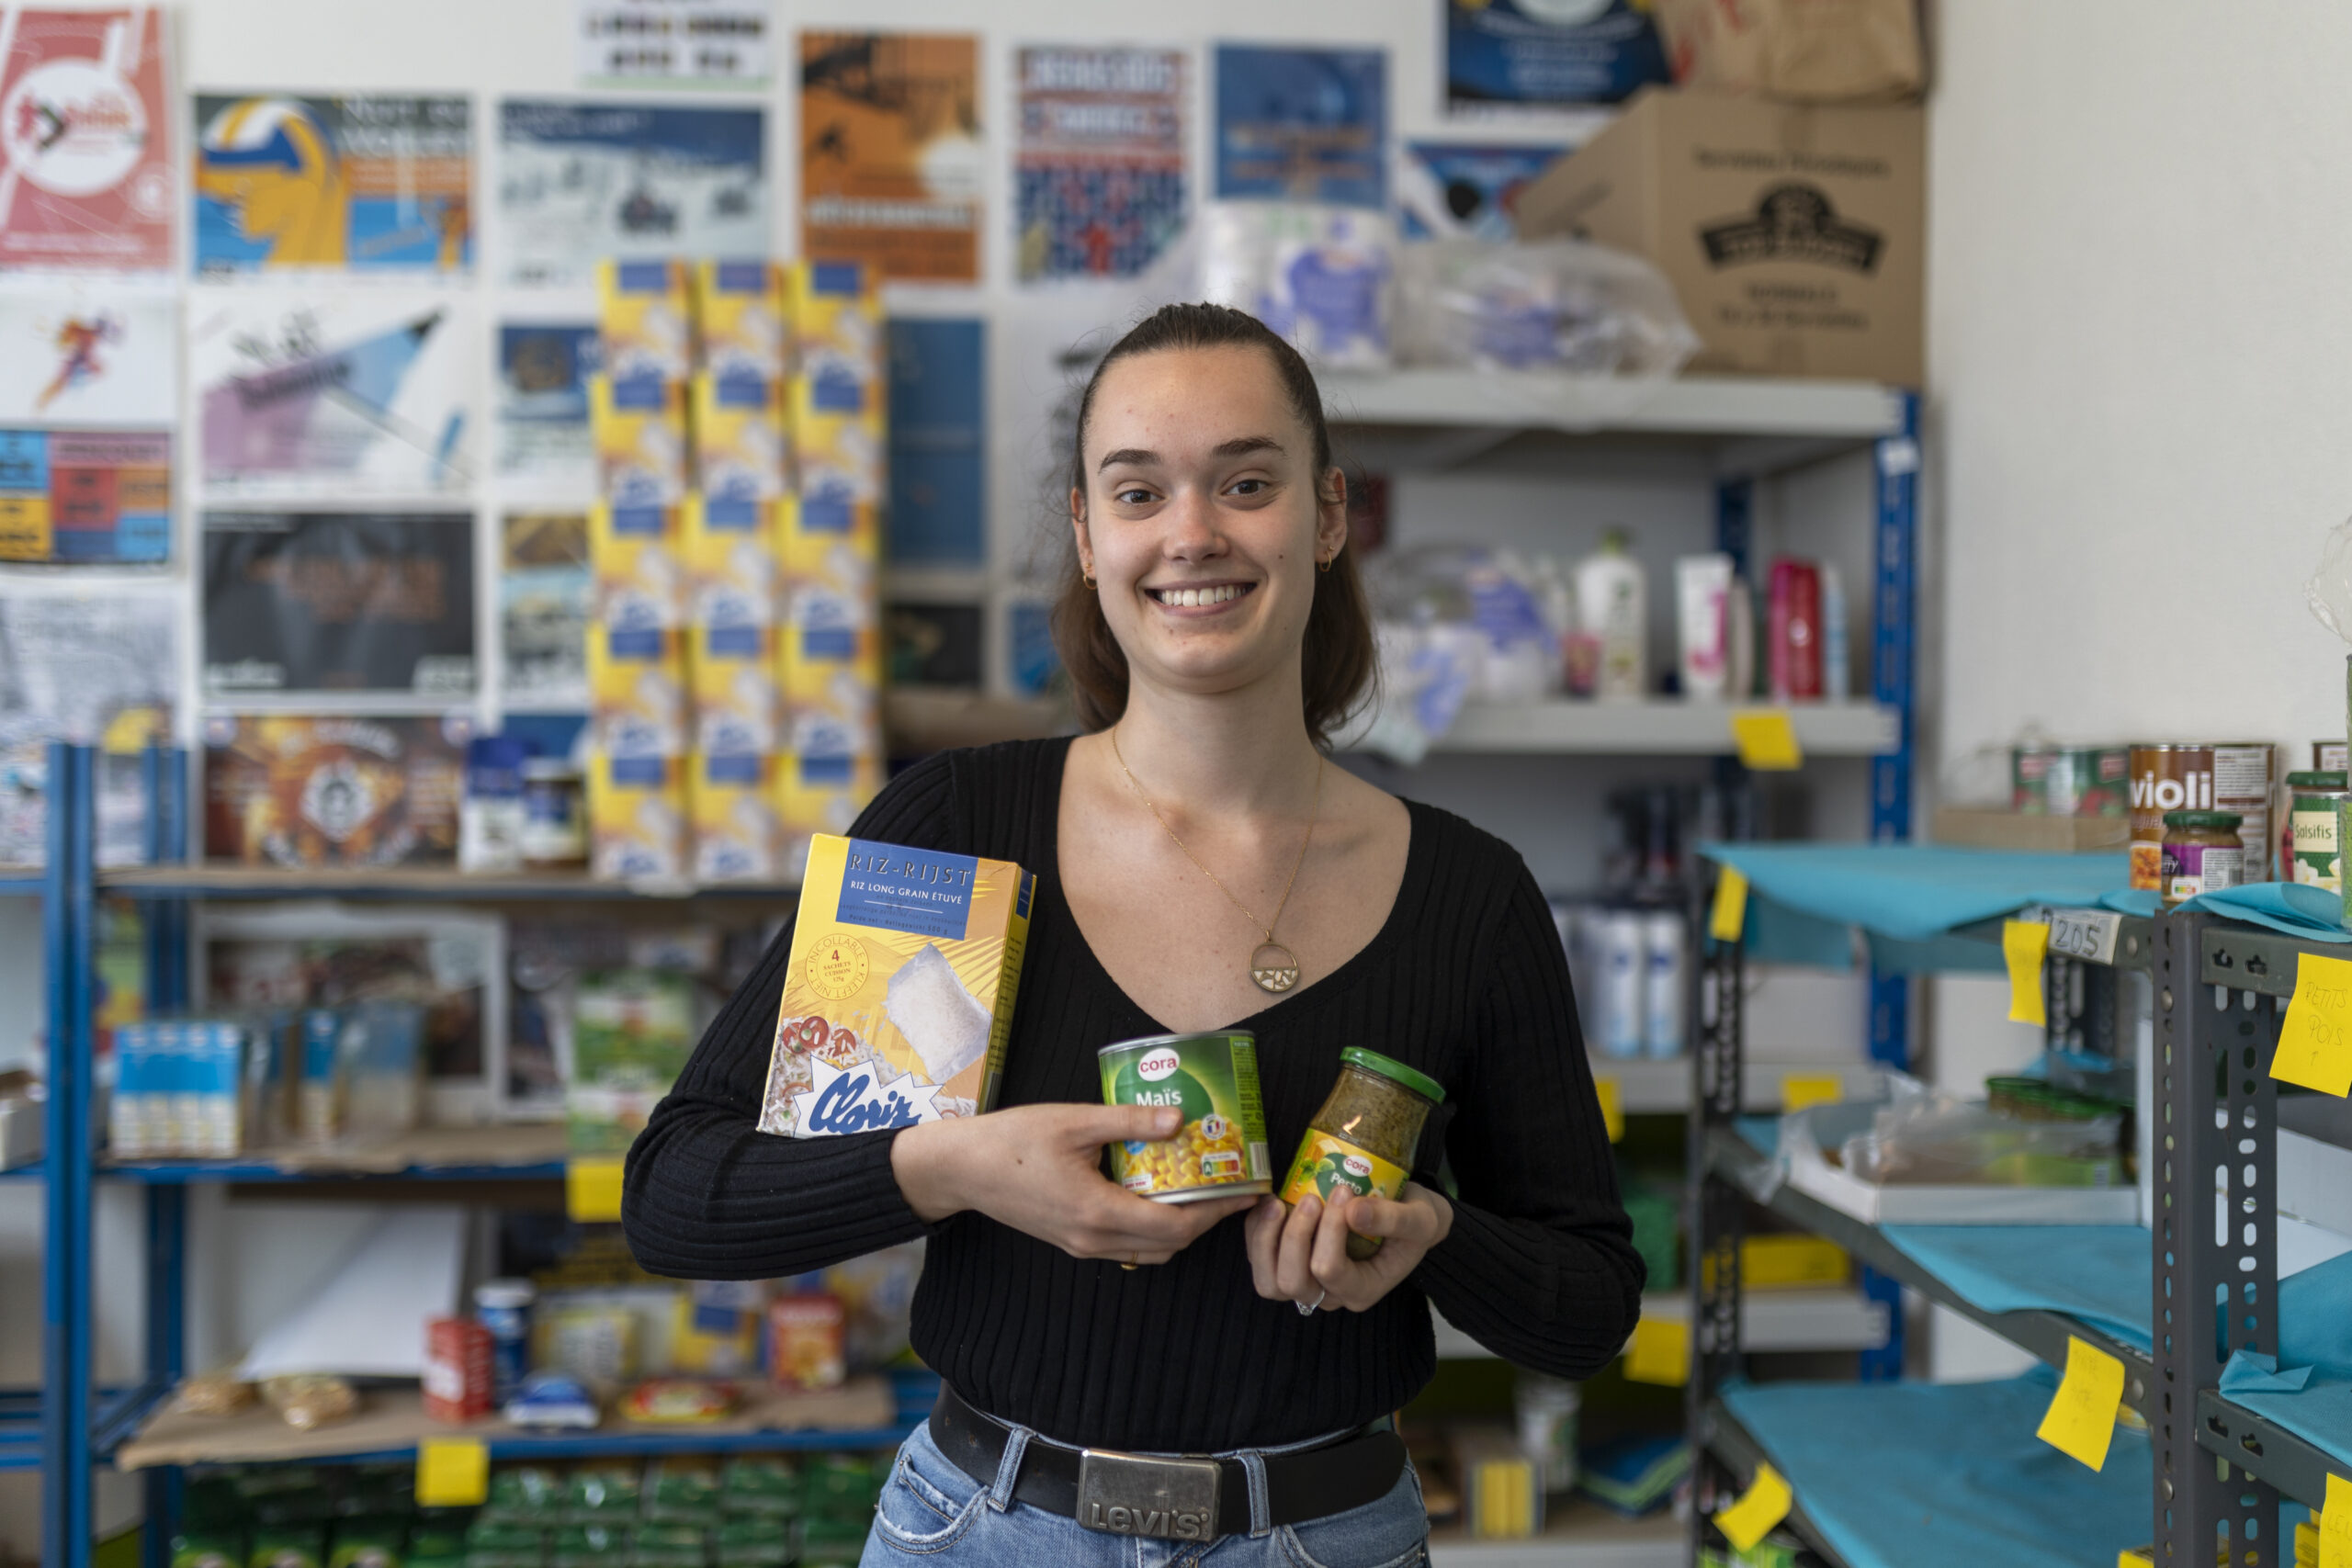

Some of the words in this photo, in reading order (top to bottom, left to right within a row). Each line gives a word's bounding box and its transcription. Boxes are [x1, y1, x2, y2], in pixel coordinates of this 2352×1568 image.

[2295, 824, 2333, 840] Salsifis
[850, 853, 971, 886] RIZ-RIJST
[851, 880, 865, 890] RIZ
[868, 884, 895, 895] LONG
[898, 887, 930, 899] GRAIN
[932, 891, 963, 905] ÉTUVÉ
[831, 949, 841, 962] 4
[2305, 980, 2348, 1010] PETITS
[2307, 1013, 2345, 1046] POIS
[1140, 1057, 1177, 1073] cora
[1136, 1088, 1183, 1108] Maïs
[1346, 1157, 1371, 1175] cora
